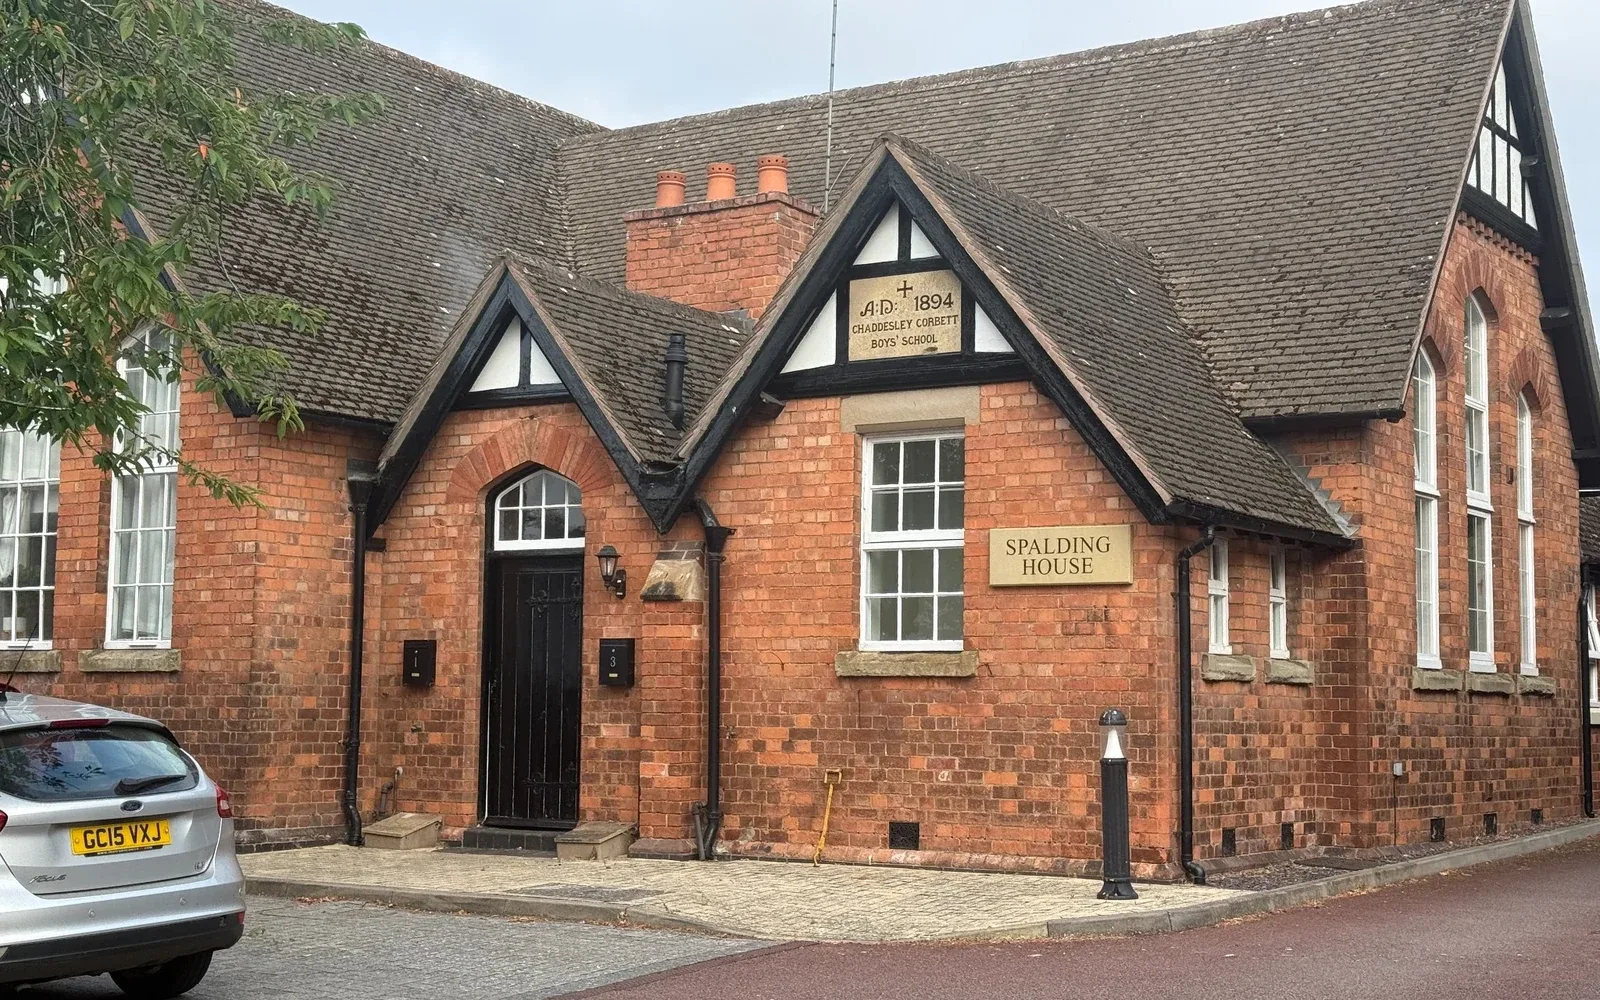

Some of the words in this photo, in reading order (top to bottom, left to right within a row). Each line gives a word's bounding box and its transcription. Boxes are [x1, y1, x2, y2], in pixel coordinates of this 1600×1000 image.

[914, 292, 954, 311] 1894
[852, 319, 913, 334] CHADDESLEY
[916, 314, 959, 328] CORBETT
[871, 335, 899, 349] BOYS'
[901, 334, 938, 346] SCHOOL
[1006, 536, 1111, 556] SPALDING
[1022, 557, 1094, 576] HOUSE
[610, 656, 616, 668] 3
[83, 826, 125, 849] GC15
[128, 822, 162, 844] VXJ
